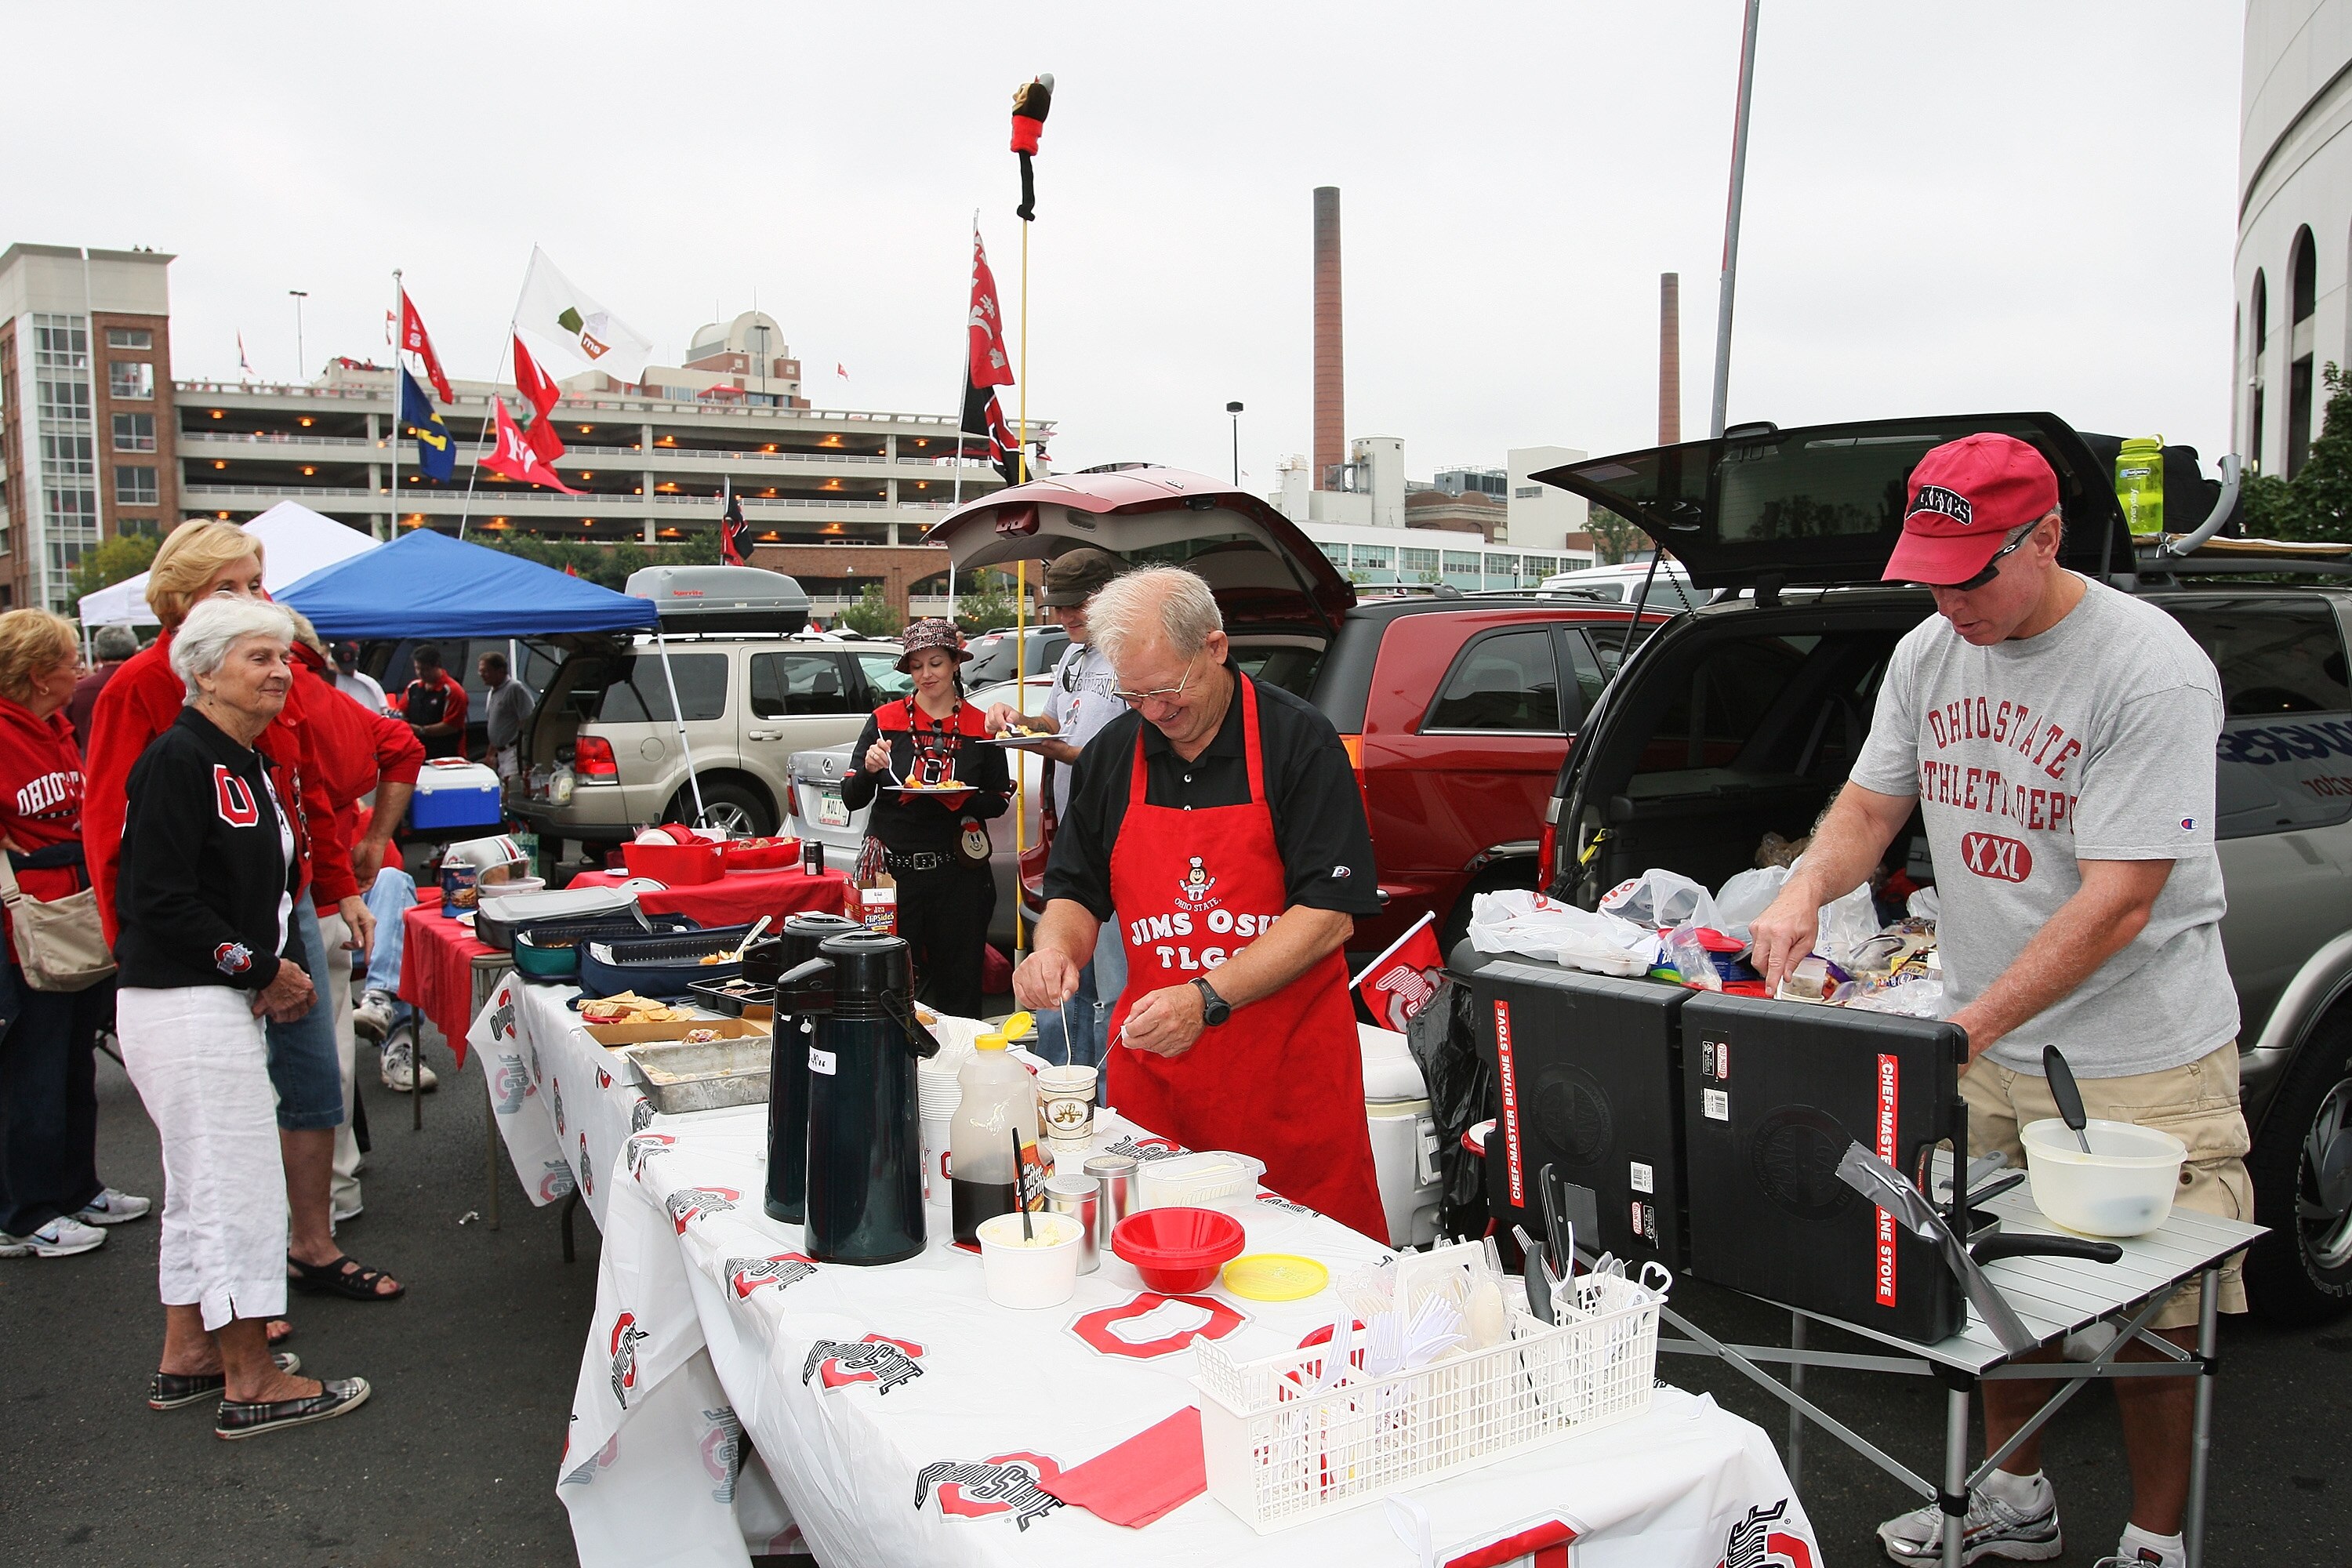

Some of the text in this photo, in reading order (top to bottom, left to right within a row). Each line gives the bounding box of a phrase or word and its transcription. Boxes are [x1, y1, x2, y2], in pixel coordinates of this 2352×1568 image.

[1928, 696, 2082, 779] OHIO STATE
[16, 771, 66, 816] OHIO
[1969, 835, 2020, 880] XXL
[1174, 897, 1192, 912] OHIO
[1131, 912, 1193, 946] JIMS
[1156, 946, 1248, 971] TLG
[1375, 965, 1427, 1002] OHIO
[1497, 1007, 1509, 1052] STOVE
[1500, 1054, 1515, 1106] BUTANE
[1880, 1247, 1893, 1298] STOVE
[844, 1344, 925, 1396] STATE
